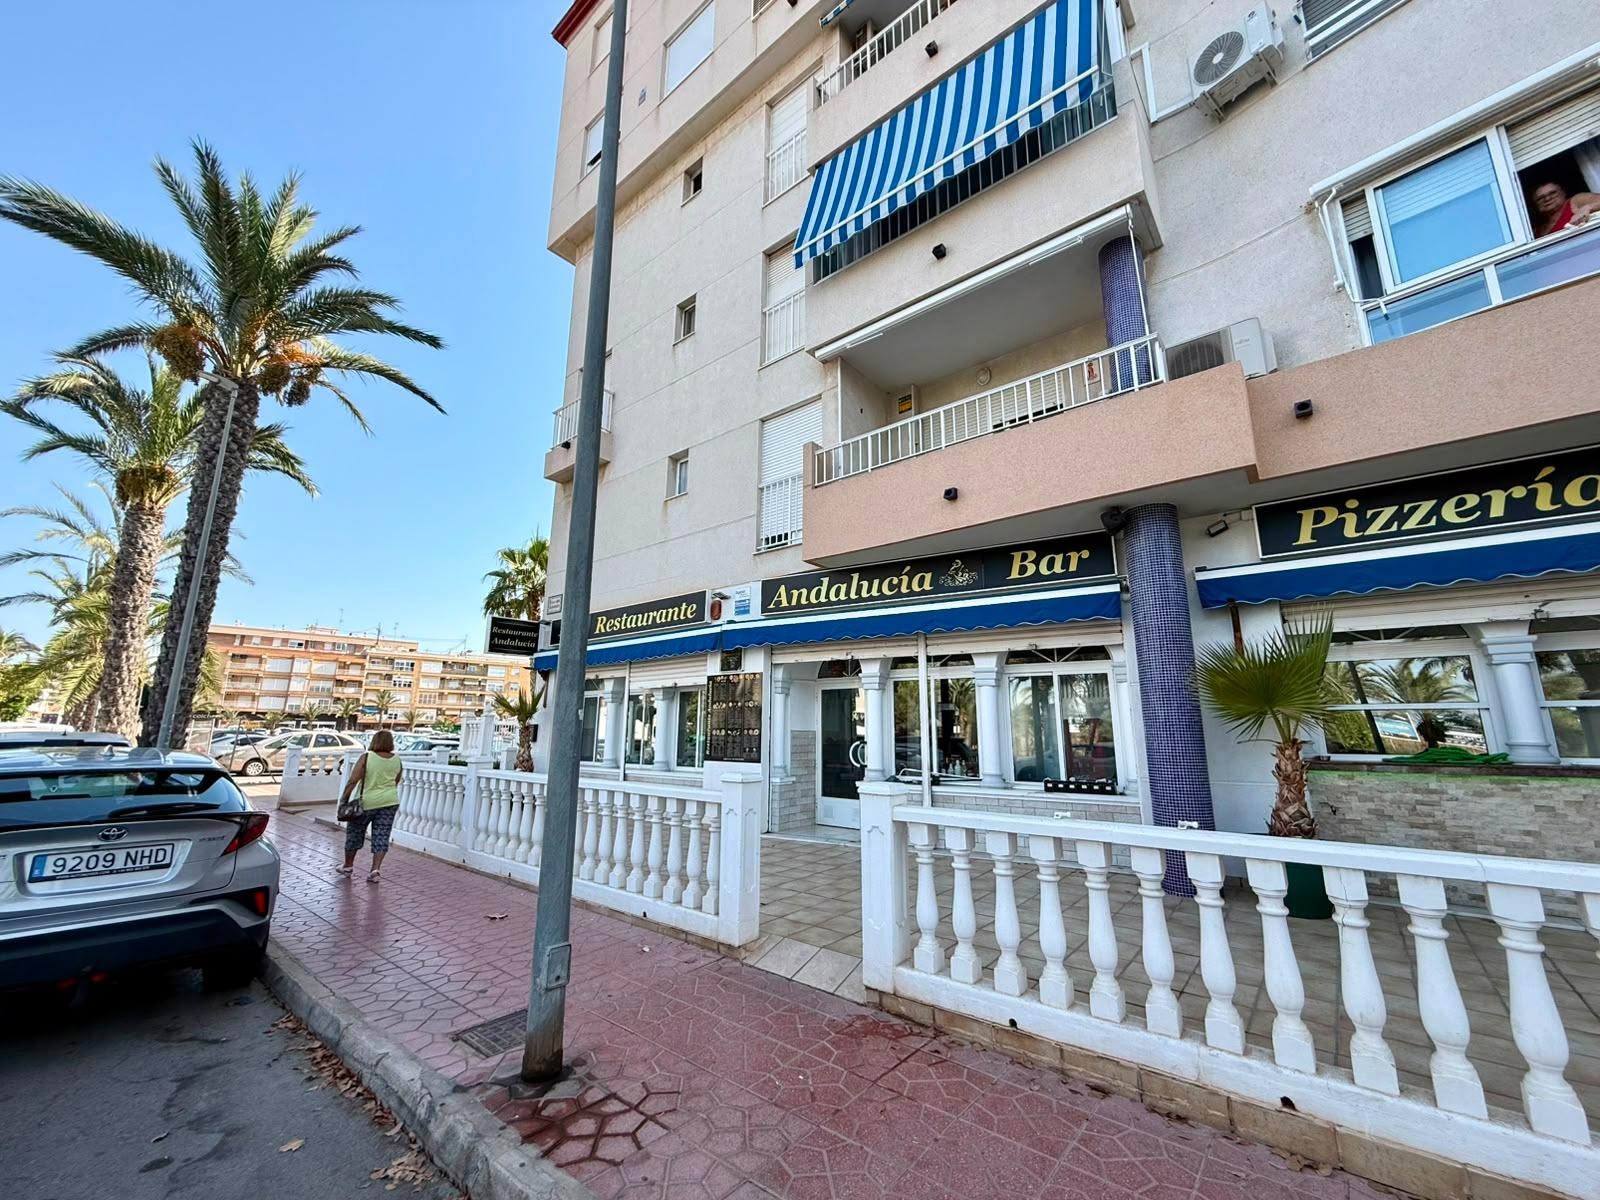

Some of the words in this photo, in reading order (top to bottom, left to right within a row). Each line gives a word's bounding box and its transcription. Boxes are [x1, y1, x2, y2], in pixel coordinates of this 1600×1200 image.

[1292, 466, 1600, 546] Pizzería
[767, 565, 934, 609] Andalucía
[1006, 549, 1090, 580] Bar
[492, 626, 538, 638] Restaurante
[594, 602, 698, 635] Restaurante
[52, 853, 116, 874] 9209
[124, 848, 167, 867] NHD
